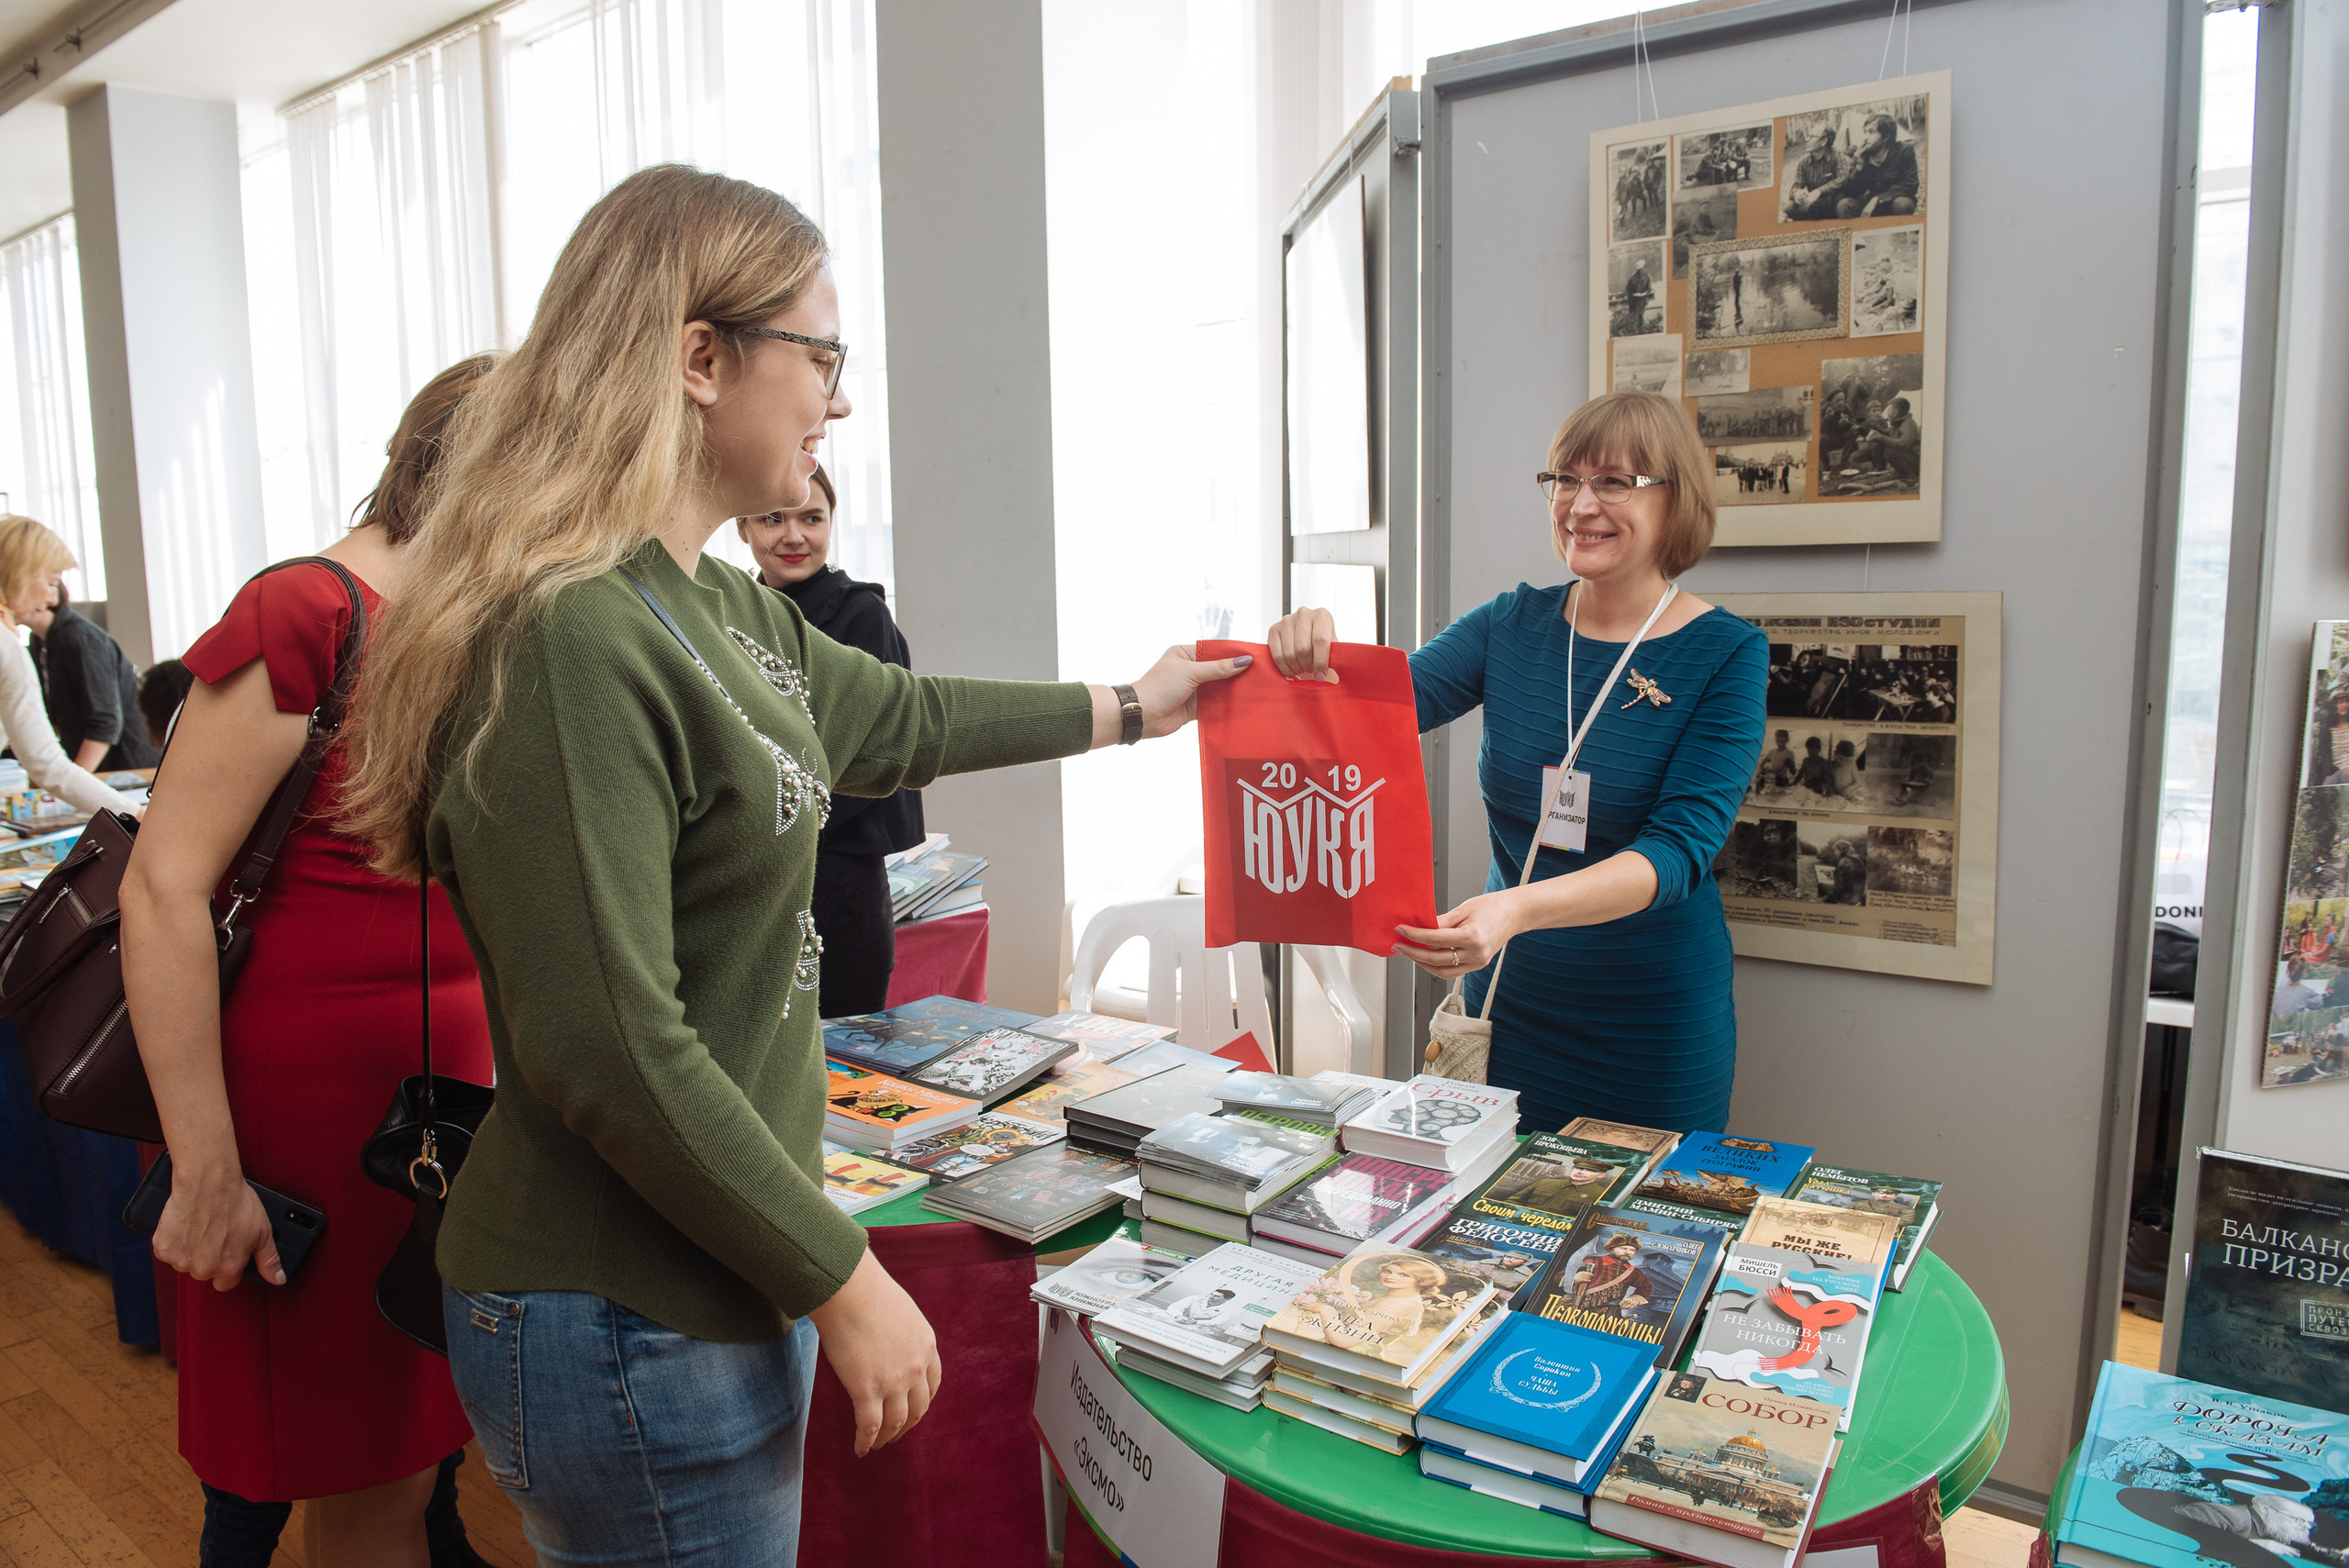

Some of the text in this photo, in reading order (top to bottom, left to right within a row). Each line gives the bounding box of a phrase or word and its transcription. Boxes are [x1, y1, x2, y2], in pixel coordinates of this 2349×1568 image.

[1261, 762, 1362, 792] 20 19
[1548, 811, 1586, 825] РГАНИЗАТОР
[1534, 1140, 1588, 1155] ПРОКОПЬЕВА
[1540, 1135, 1557, 1143] ЗОЯ
[1736, 1140, 1759, 1150] 100
[1701, 1145, 1781, 1163] ВЕЛИКИХ
[1712, 1154, 1759, 1165] ЗАГАДОК
[1701, 1158, 1762, 1173] ГЕОГРАФИИ
[1814, 1166, 1844, 1175] ОЛЕГ
[1811, 1171, 1869, 1184] НЕМЫТОВ
[1473, 1199, 1573, 1230] Своим чередом
[1634, 1199, 1695, 1216] ДМИТРИЙ
[1630, 1204, 1740, 1229] МАМИН-СИБИРЯК
[1449, 1226, 1561, 1253] ФЕДОСЕЕВ
[1453, 1218, 1564, 1246] ГРИГОРИЙ
[1651, 1241, 1697, 1255] СЛОБОДЧИКОВ
[1682, 1242, 1699, 1251] ОЛЕГ
[1771, 1241, 1853, 1260] РУССКИЕ!
[1784, 1234, 1812, 1245] МЫ
[1815, 1240, 1842, 1251] ЖЕ
[1738, 1264, 1777, 1276] БЮССИ
[1740, 1258, 1778, 1269] МИШЕЛЬ
[2222, 1242, 2349, 1288] ПРИЗРА
[1230, 1265, 1294, 1287] ДРУГАЯ
[1824, 1278, 1860, 1288] РУССКОМ
[1828, 1273, 1861, 1284] ВПЕРВЫЕ
[1069, 1296, 1110, 1310] КНИЖНАЯ
[1302, 1314, 1384, 1344] ЖИЗНИ
[1722, 1313, 1846, 1344] НЕ ЗАБЫВАТЬ
[2309, 1314, 2349, 1327] ПУТЕ
[2309, 1323, 2347, 1335] СКВОЗ
[1736, 1329, 1824, 1355] НИКОГДА
[1533, 1362, 1572, 1377] Сорокин
[1534, 1356, 1581, 1373] Валентин
[1702, 1393, 1829, 1429] СОБОР
[1764, 1396, 1831, 1415] Ирина Измайлова
[2240, 1404, 2288, 1418] Ушаков
[1071, 1360, 1152, 1482] Издательство
[2171, 1400, 2332, 1446] ДОРОГА
[2195, 1421, 2323, 1457] СКАЗАМ
[1074, 1437, 1125, 1512] «Эксмо»
[1630, 1496, 1664, 1510] Роман
[1675, 1508, 1761, 1534] архитектурой
